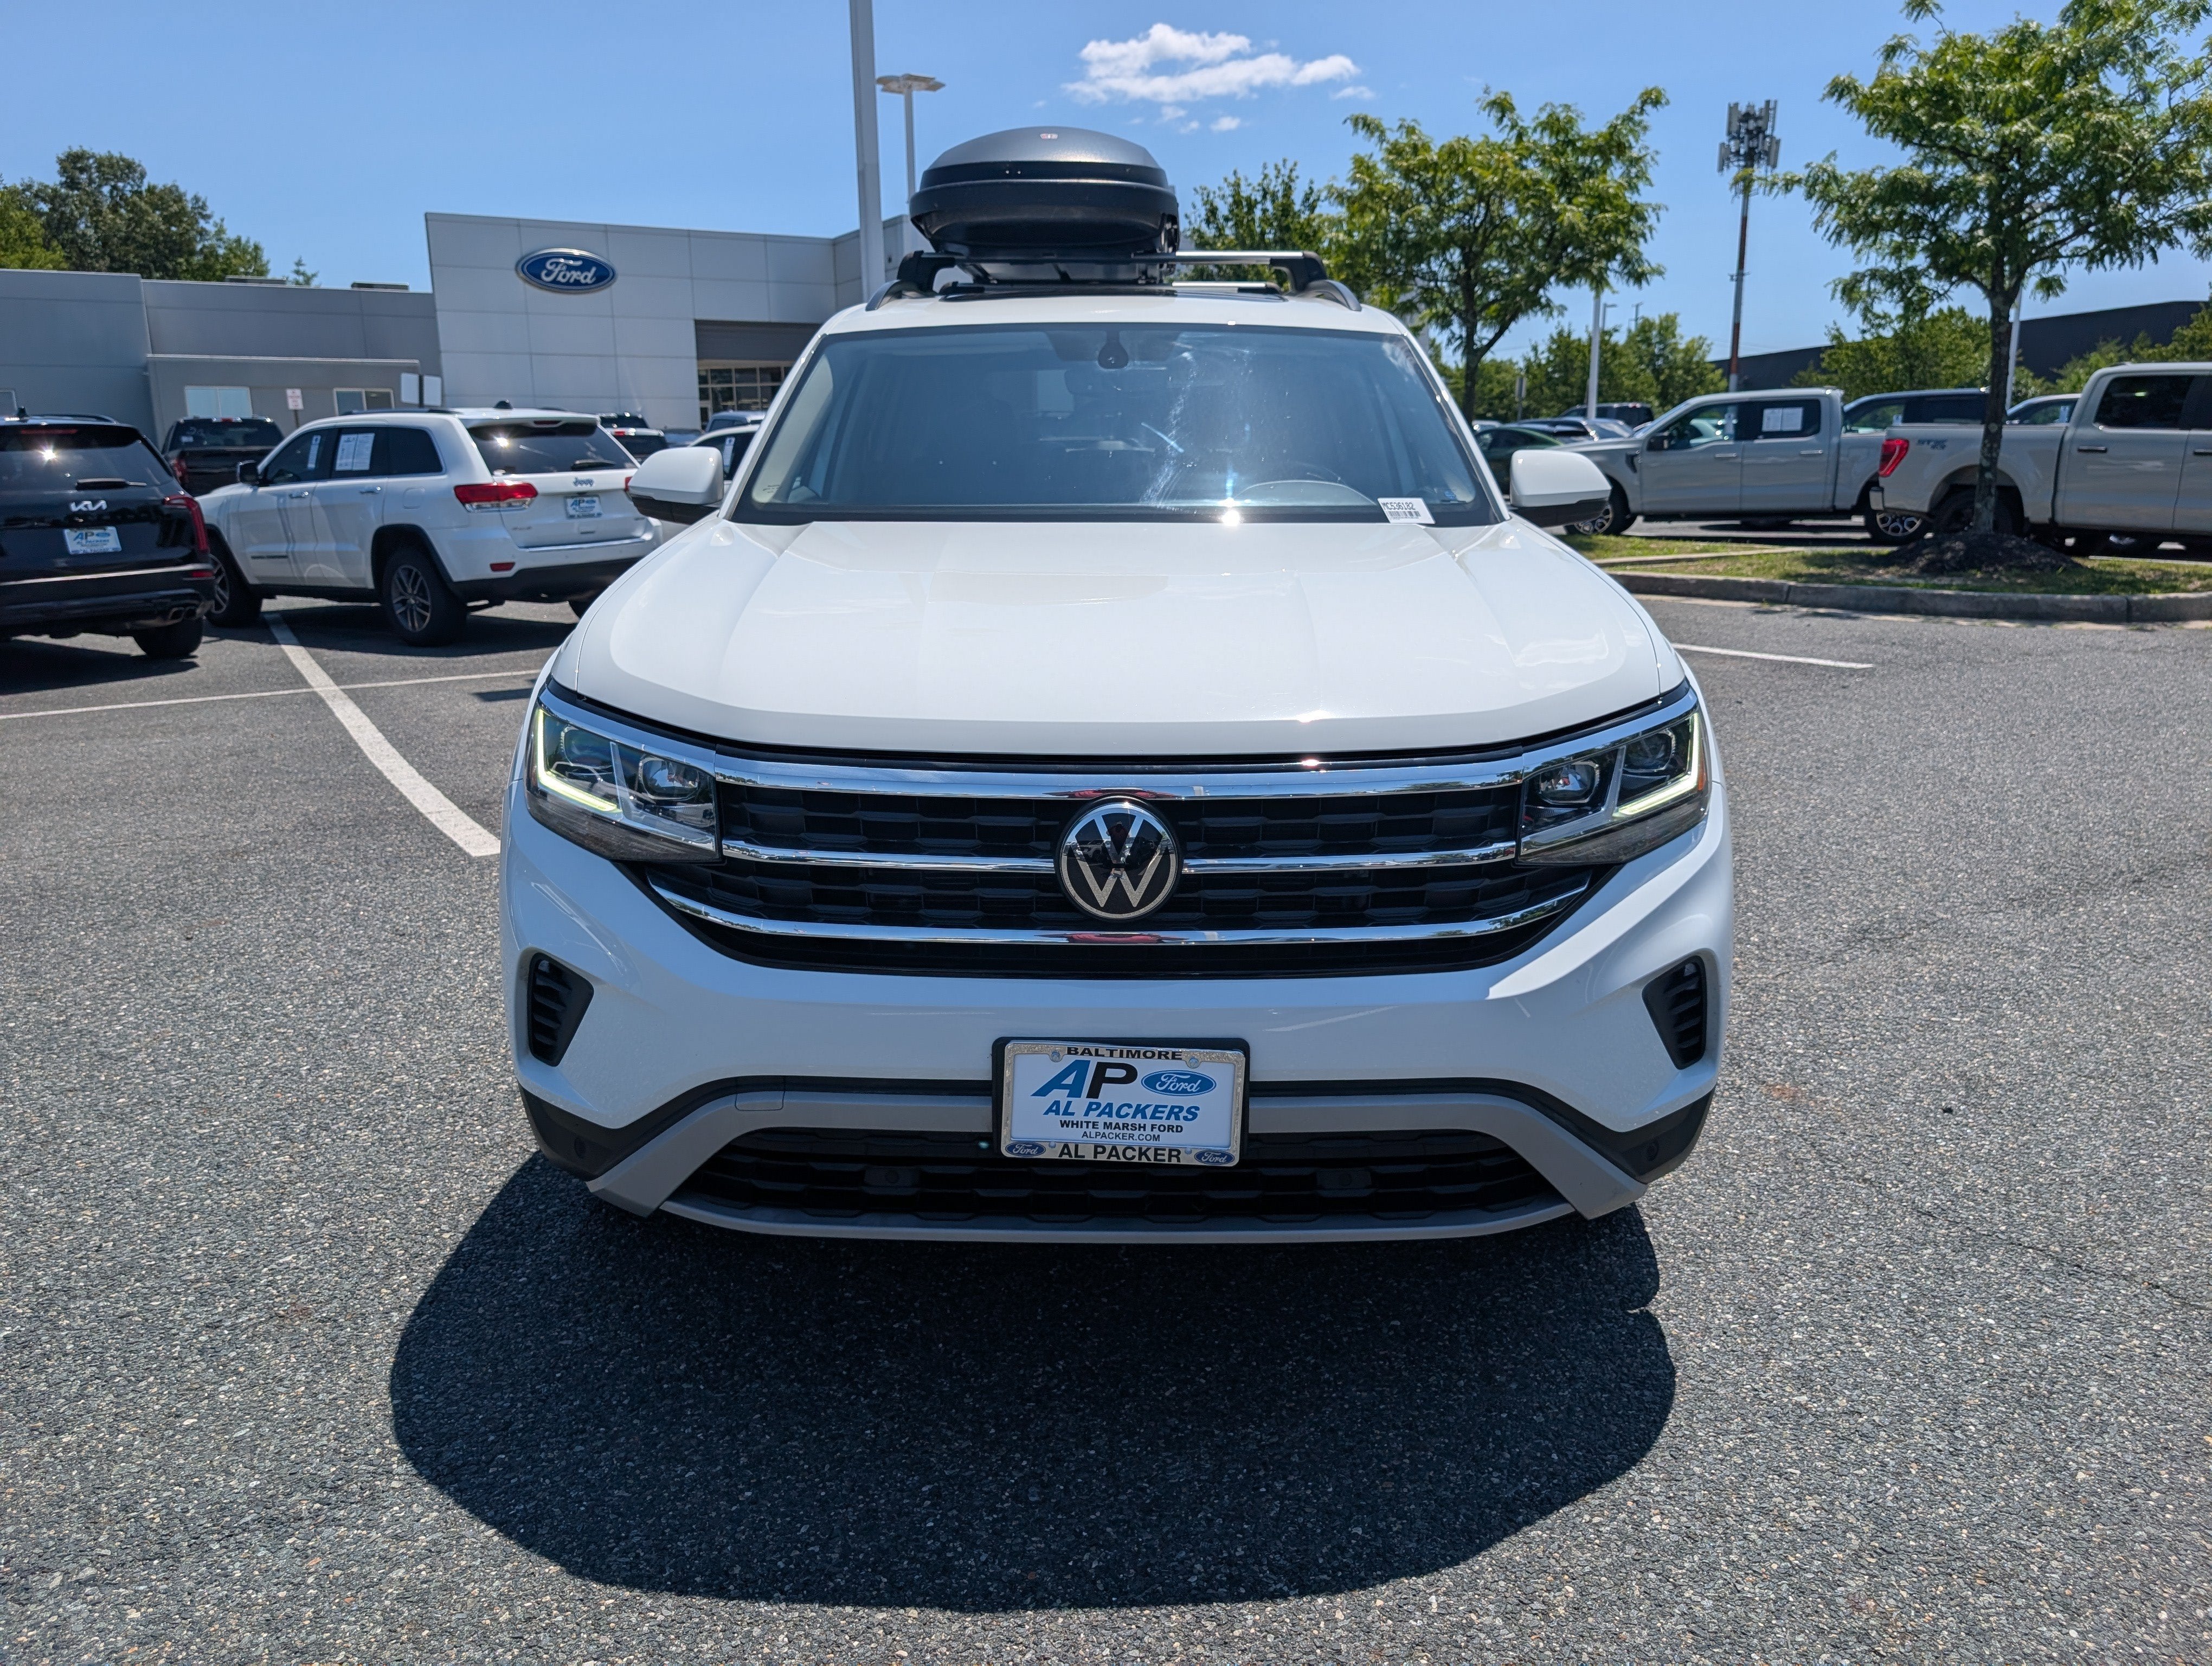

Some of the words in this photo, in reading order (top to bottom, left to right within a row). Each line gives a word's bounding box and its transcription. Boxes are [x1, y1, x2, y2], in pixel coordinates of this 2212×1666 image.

[541, 258, 597, 284] Ford
[1067, 1046, 1183, 1060] BALTIMORE
[1030, 1059, 1139, 1099] AP
[1155, 1073, 1202, 1092] Ford
[1042, 1100, 1076, 1116] AL
[1083, 1101, 1200, 1122] PACKERS
[1059, 1119, 1099, 1130] WHITE
[1103, 1122, 1147, 1132] MARSH
[1150, 1124, 1183, 1133] FORD
[1082, 1131, 1161, 1142] ALPACKER.COM
[1012, 1143, 1039, 1155] Ford
[1058, 1143, 1085, 1159] AL
[1093, 1144, 1181, 1163] PACKER
[1201, 1151, 1227, 1163] Ford
